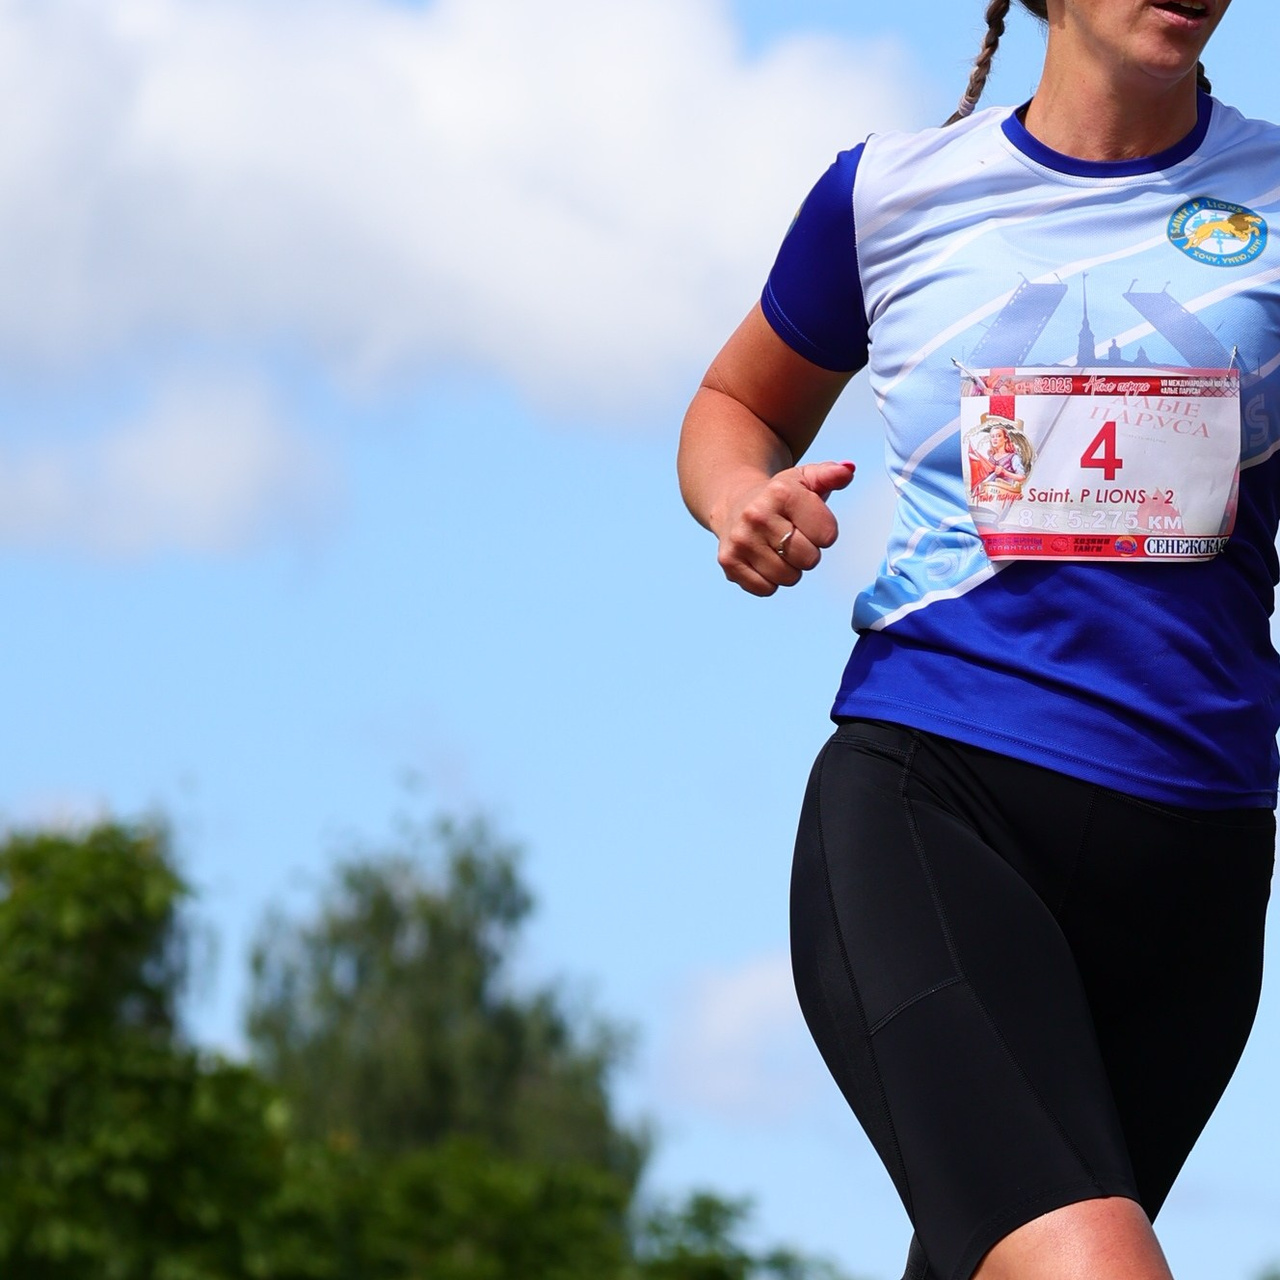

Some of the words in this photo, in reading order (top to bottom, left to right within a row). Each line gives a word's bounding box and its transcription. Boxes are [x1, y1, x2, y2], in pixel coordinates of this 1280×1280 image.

[1206, 200, 1244, 213] LIONS
[1042, 377, 1073, 394] 2025
[1089, 406, 1211, 439] ПАРУСА
[1080, 421, 1123, 481] 4
[1027, 487, 1074, 503] Saint.
[1080, 489, 1090, 503] P
[1095, 489, 1146, 504] LIONS
[1164, 489, 1174, 504] 2
[1018, 509, 1033, 528] 8
[1067, 510, 1139, 530] 5.275
[1146, 537, 1227, 554] СЕНЕЖСКАЯ
